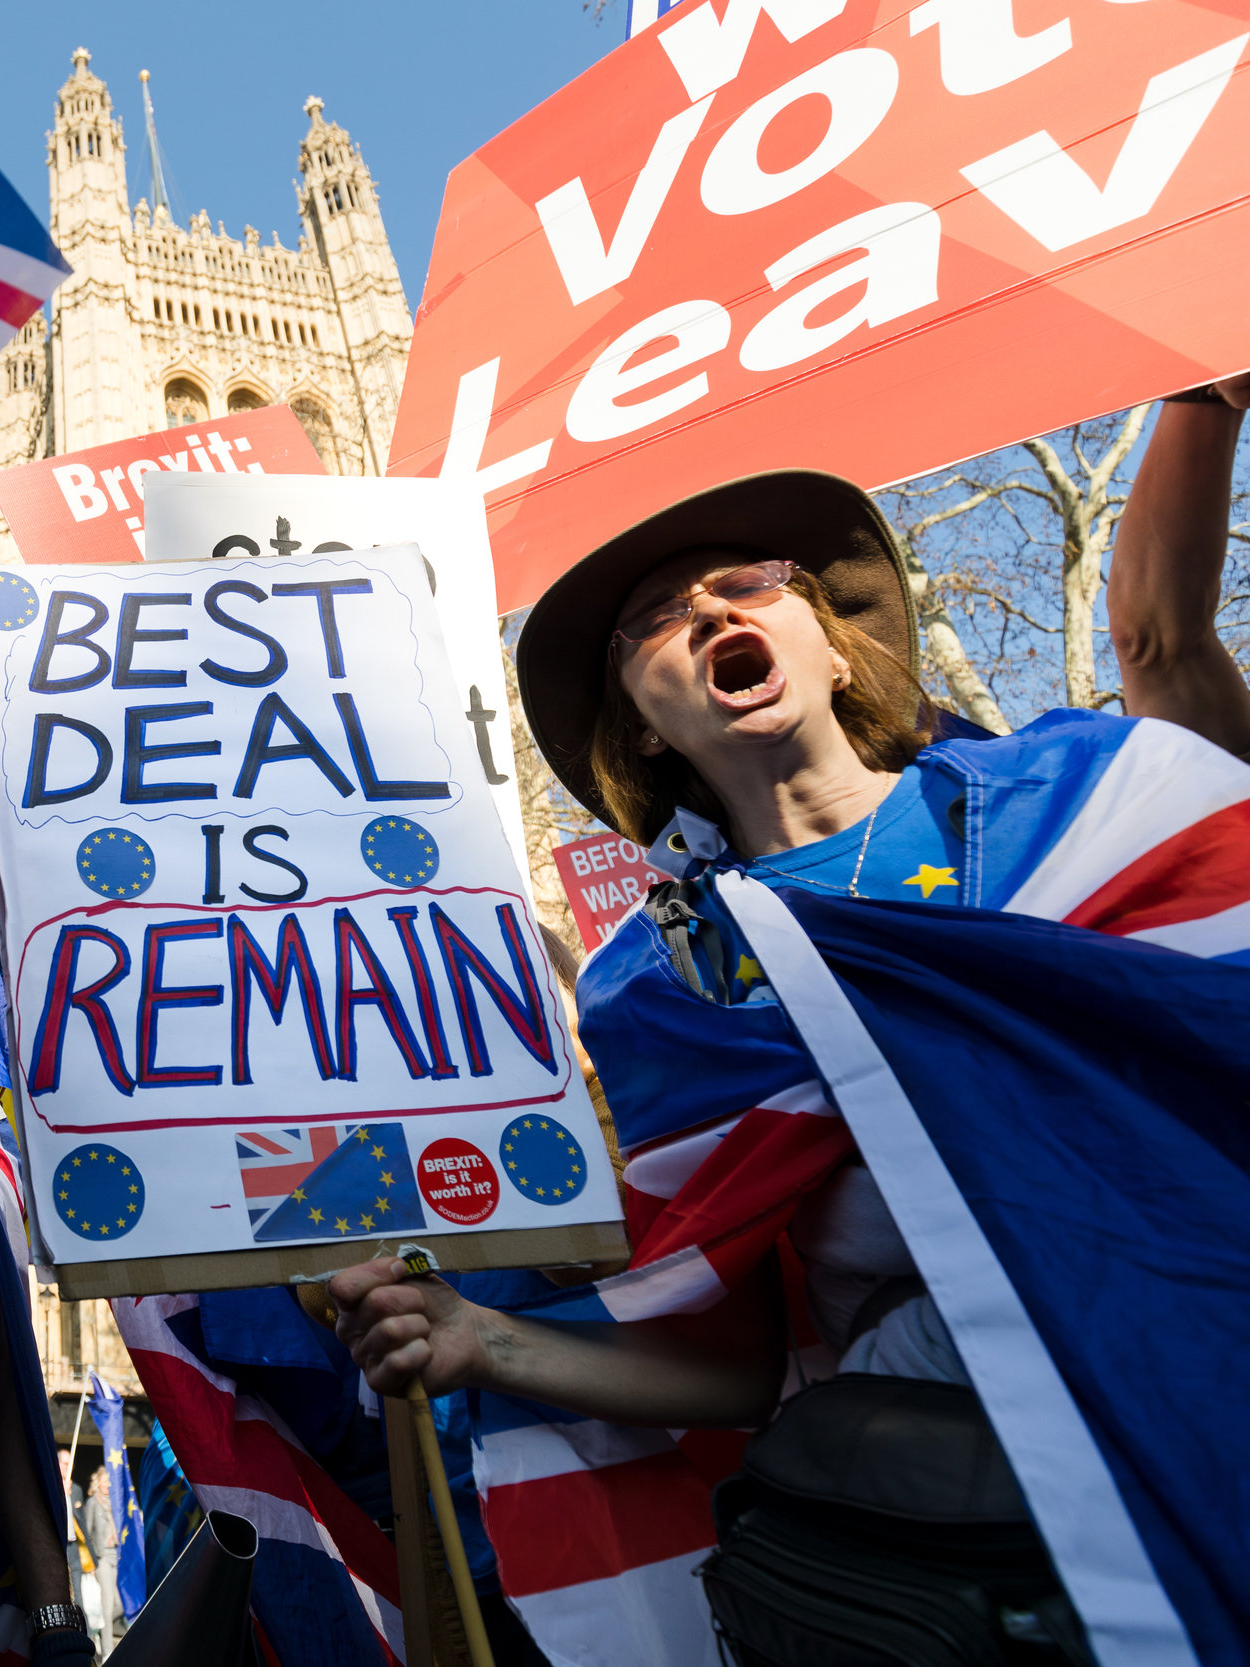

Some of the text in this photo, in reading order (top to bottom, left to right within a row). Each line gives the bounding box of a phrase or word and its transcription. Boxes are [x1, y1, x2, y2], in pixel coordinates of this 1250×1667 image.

[28, 578, 374, 695] BEST
[22, 691, 452, 809] DEAL
[201, 824, 308, 905] IS
[580, 876, 642, 913] WAR
[27, 902, 559, 1097] REMAIN
[423, 1155, 484, 1173] BREXIT:
[429, 1181, 492, 1200] worth it?
[443, 1170, 472, 1185] is it
